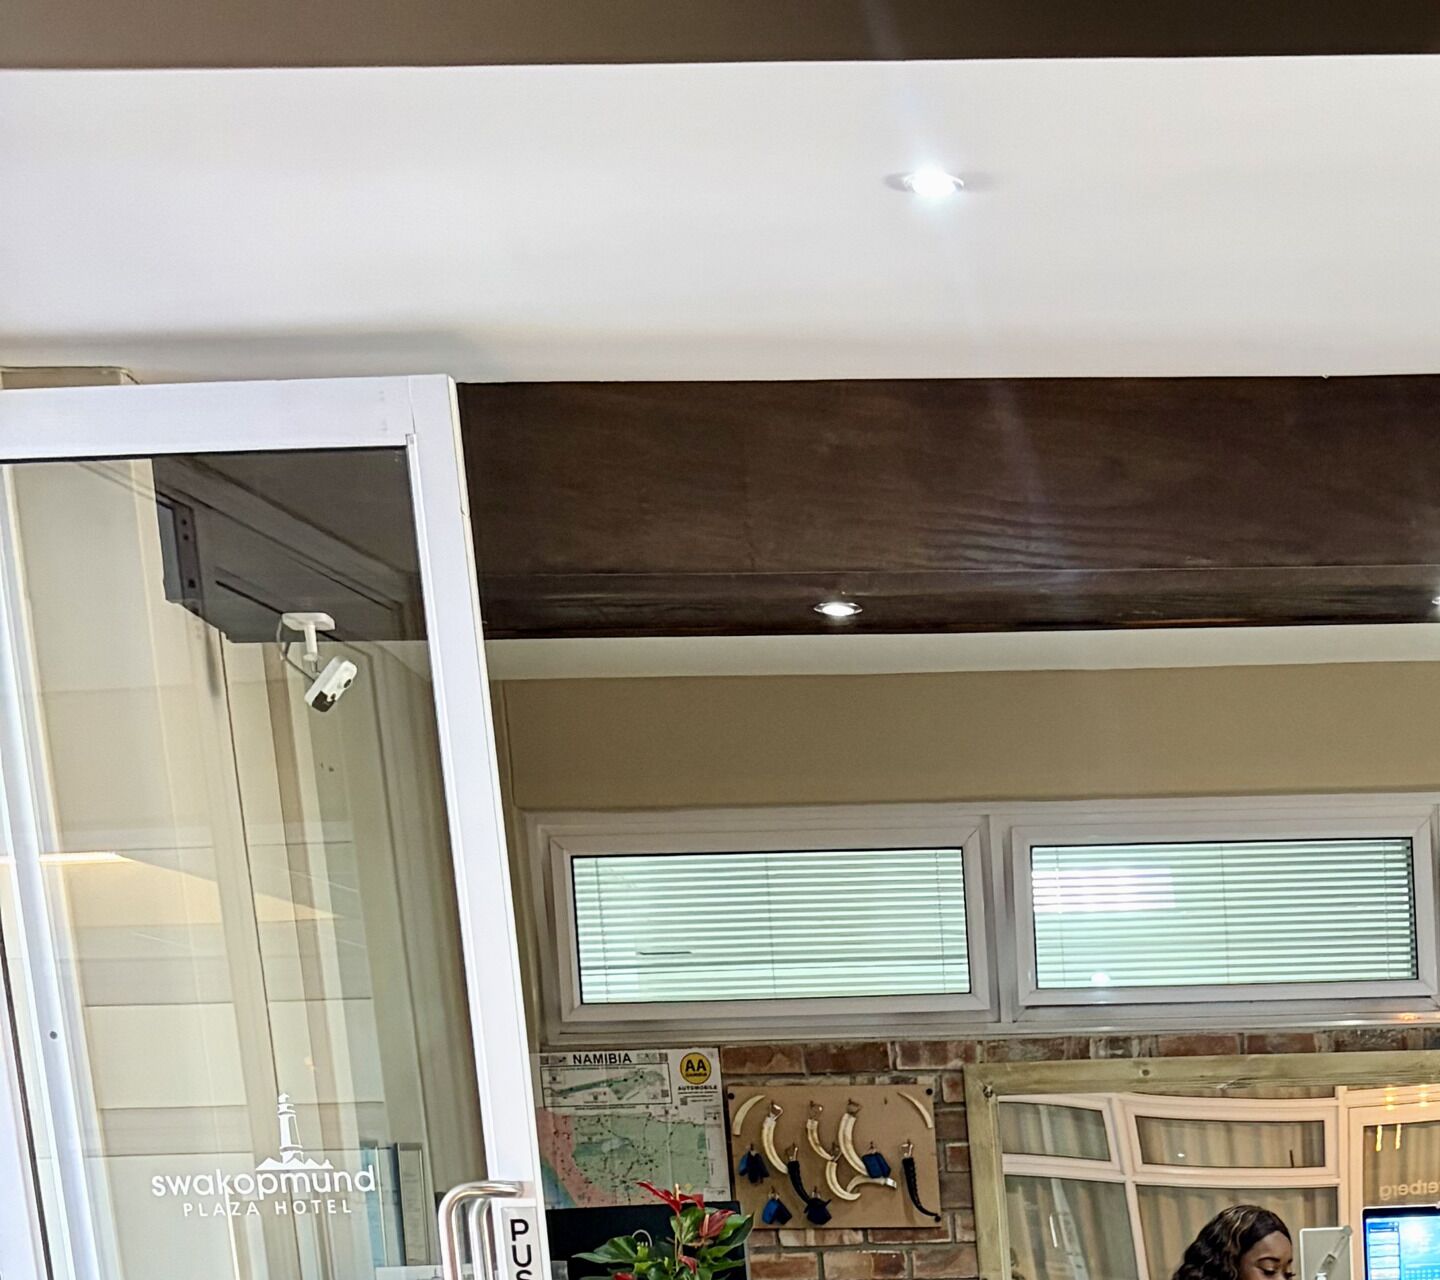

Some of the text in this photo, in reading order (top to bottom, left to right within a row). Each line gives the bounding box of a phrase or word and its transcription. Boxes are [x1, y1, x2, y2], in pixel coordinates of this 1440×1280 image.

[572, 1052, 633, 1065] NAMIBIA
[685, 1059, 707, 1072] AA
[151, 1164, 377, 1201] swakopmund
[184, 1199, 353, 1217] PLAZA HOTEL
